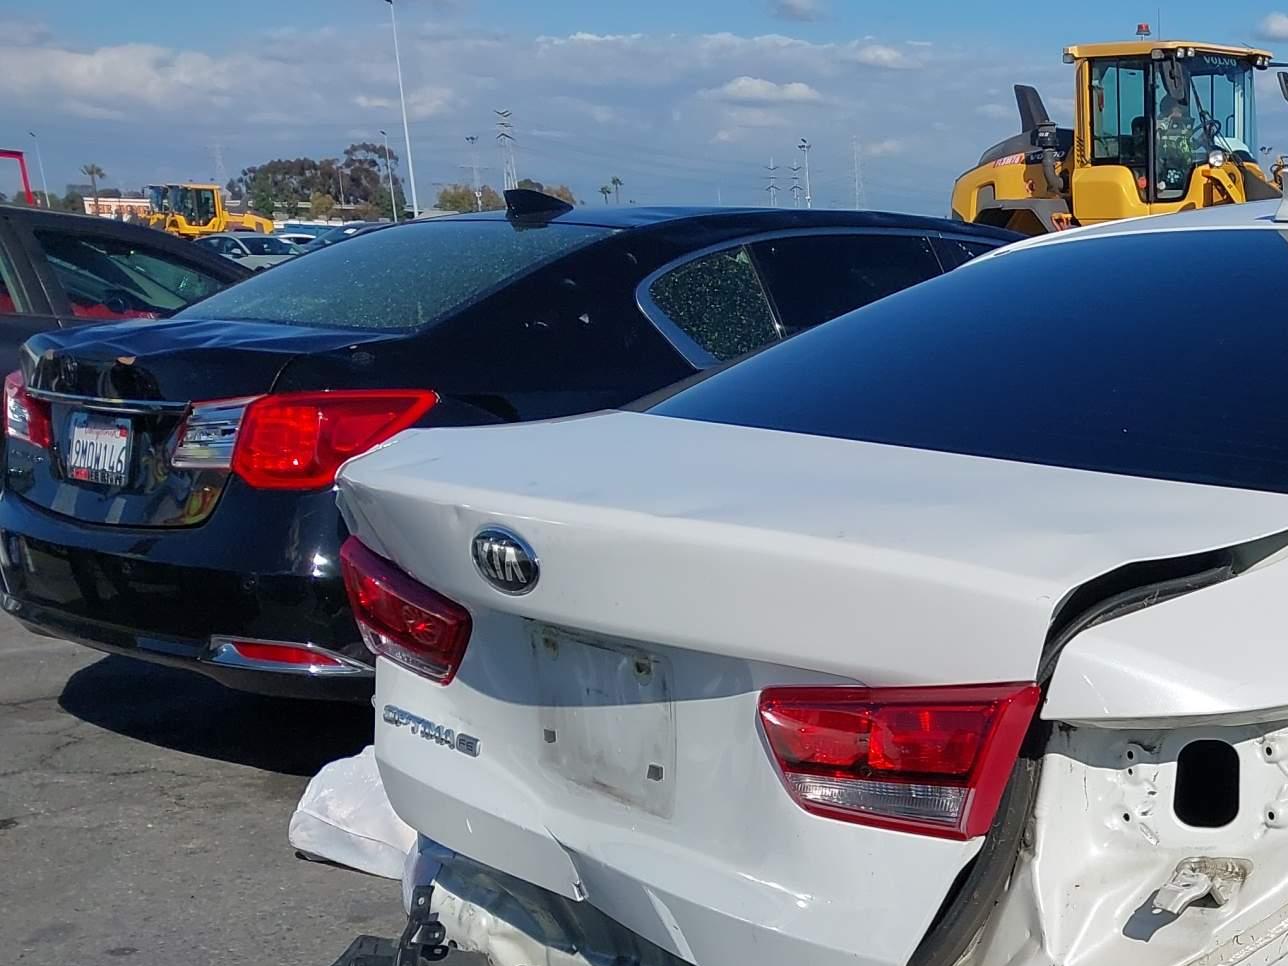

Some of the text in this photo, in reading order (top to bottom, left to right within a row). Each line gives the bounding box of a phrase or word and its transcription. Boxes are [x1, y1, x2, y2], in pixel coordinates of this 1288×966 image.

[1203, 55, 1237, 67] VOLVO
[477, 539, 528, 584] KIA
[383, 704, 456, 750] OPTIMA
